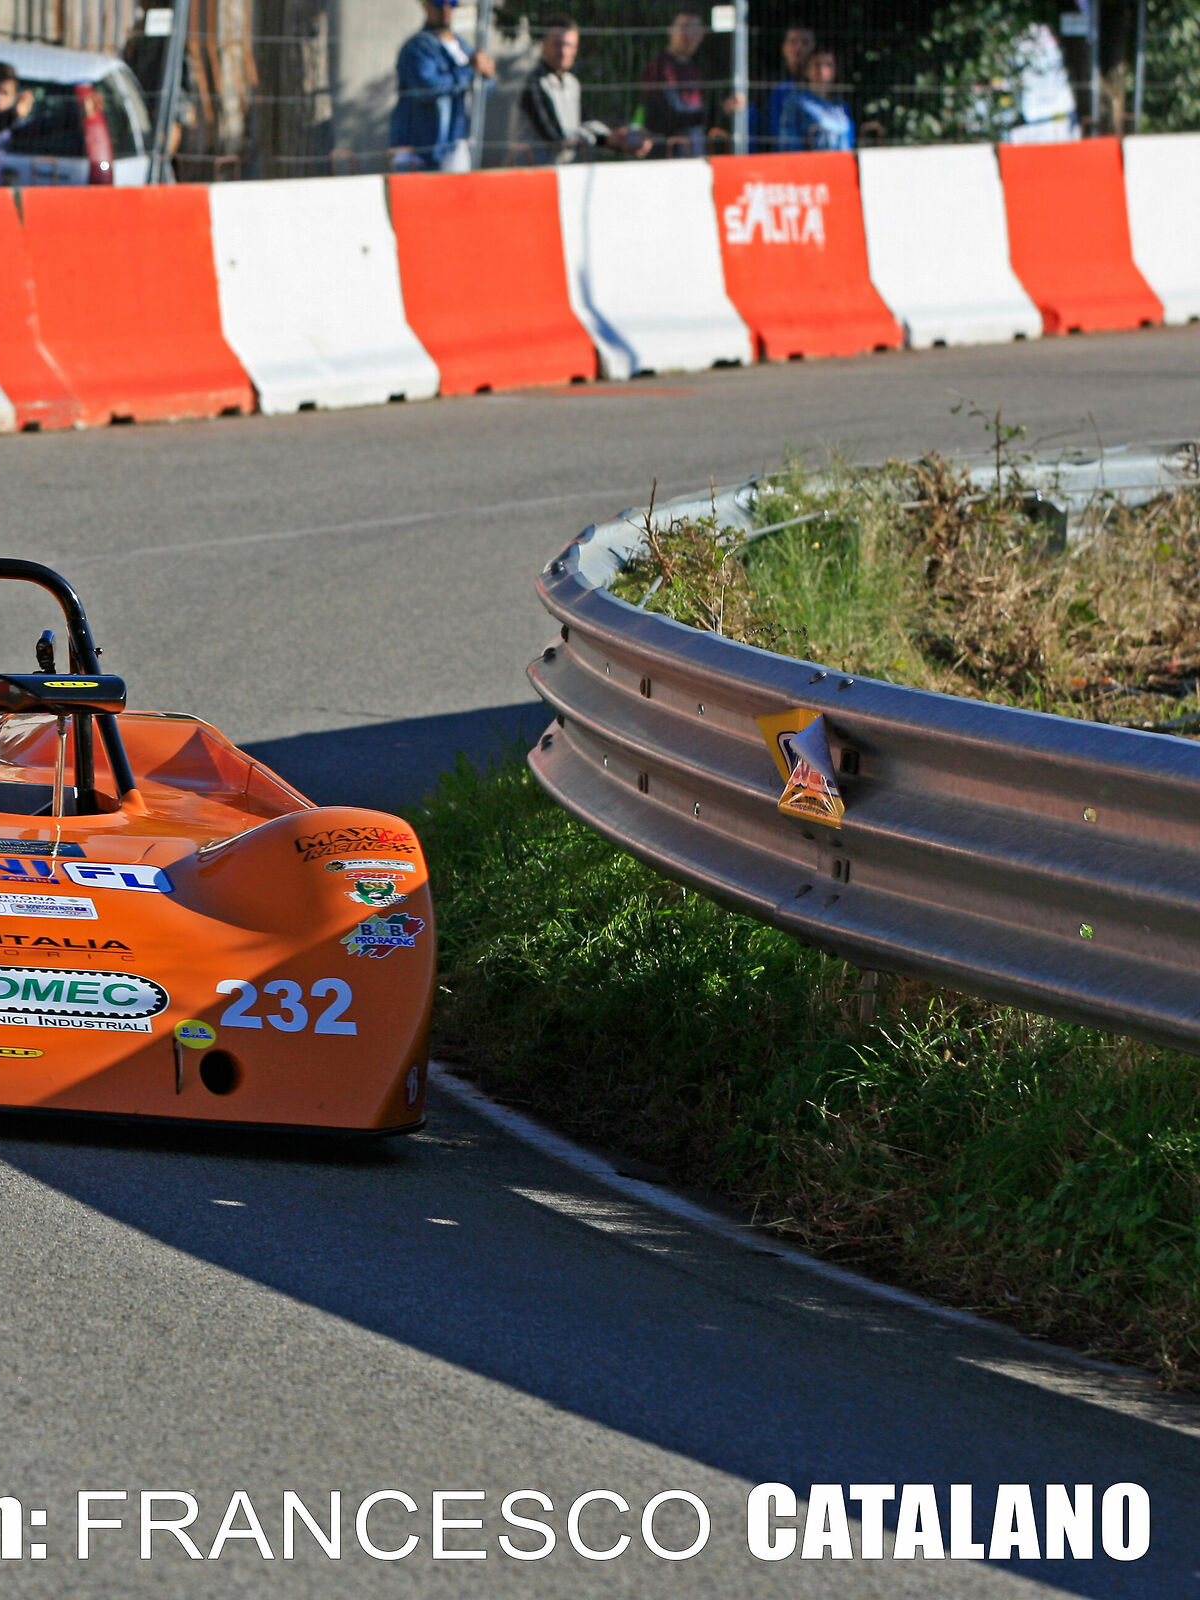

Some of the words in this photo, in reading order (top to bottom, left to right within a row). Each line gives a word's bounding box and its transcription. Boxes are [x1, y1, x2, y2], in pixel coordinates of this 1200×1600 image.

[294, 827, 386, 853] MAXI
[303, 841, 394, 861] RACING
[355, 936, 415, 947] PRO-RACING
[216, 977, 358, 1036] 232
[38, 1015, 149, 1032] INDUSTRIALI
